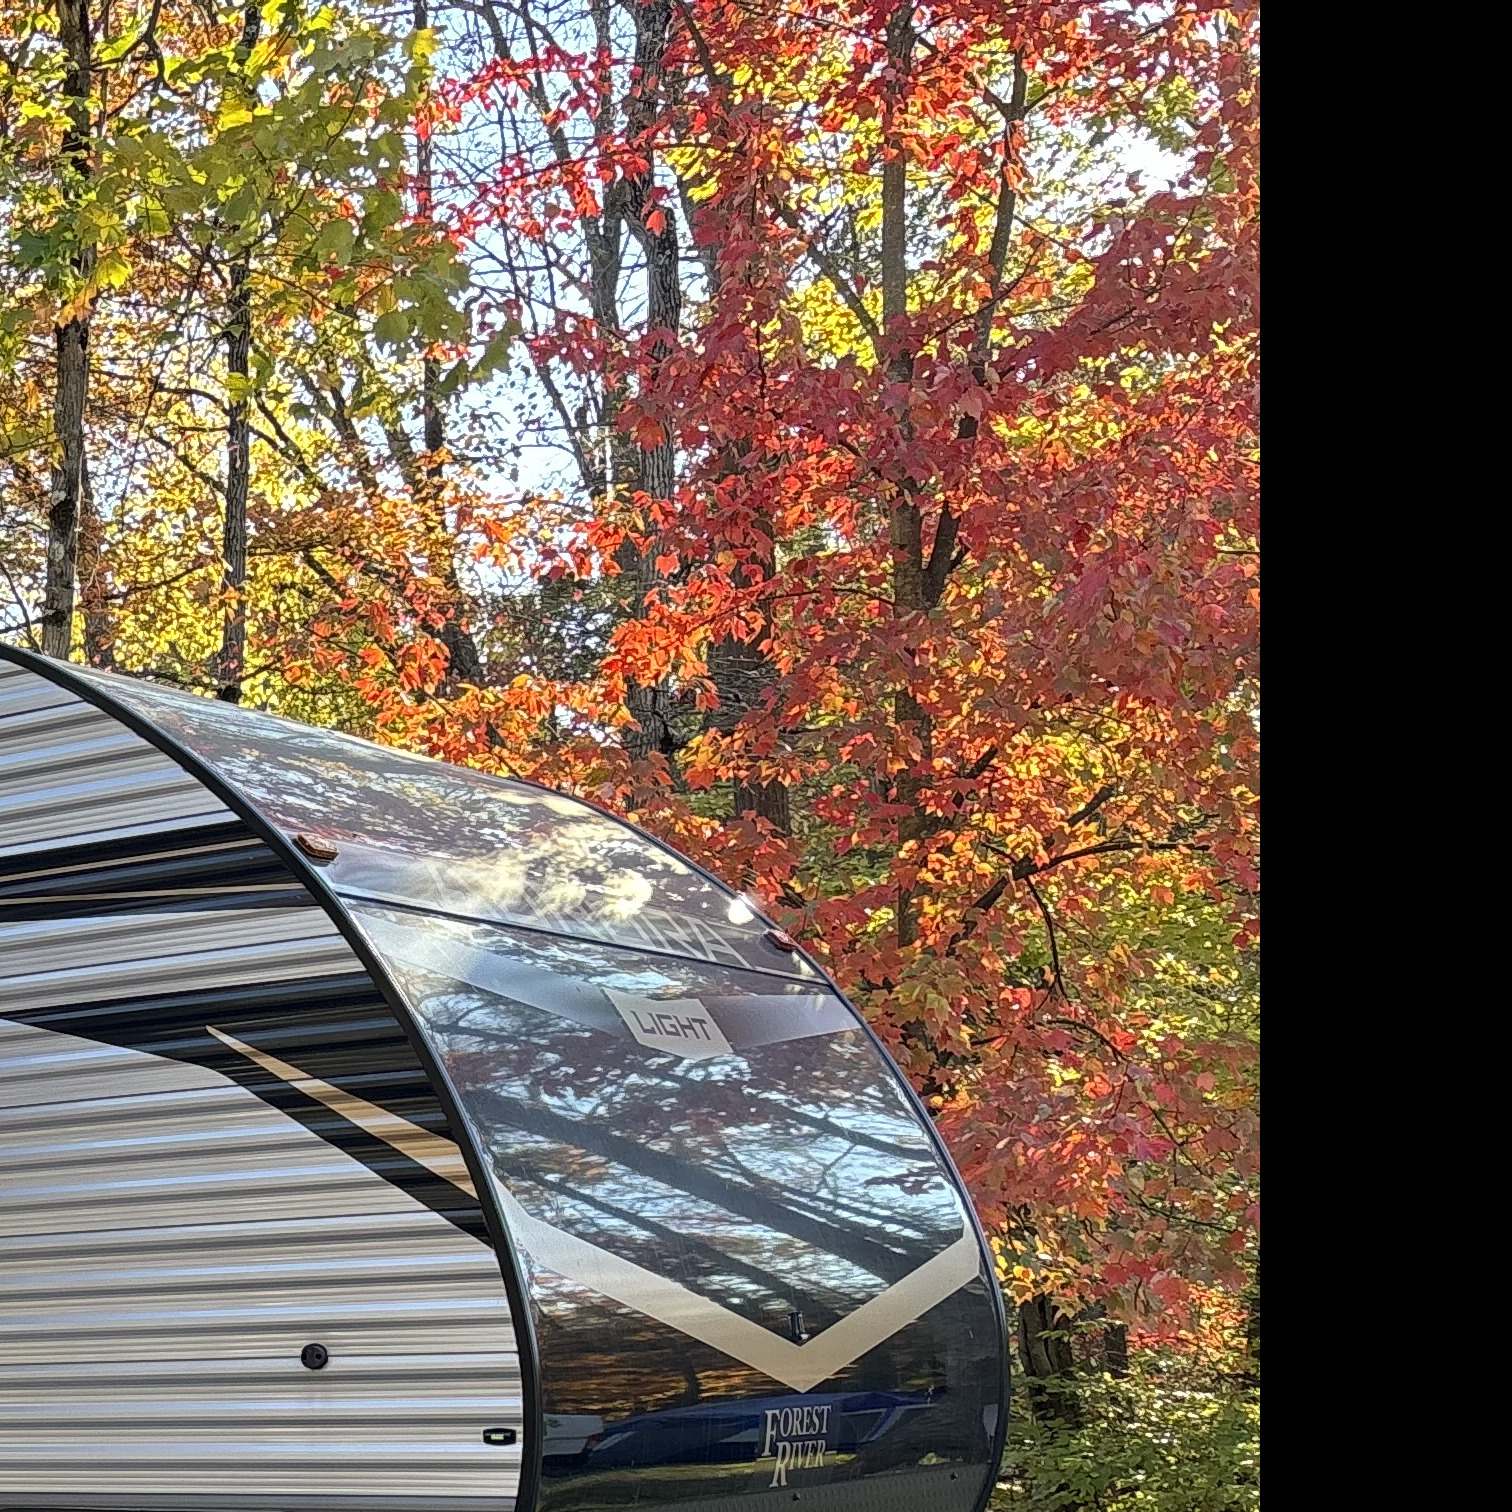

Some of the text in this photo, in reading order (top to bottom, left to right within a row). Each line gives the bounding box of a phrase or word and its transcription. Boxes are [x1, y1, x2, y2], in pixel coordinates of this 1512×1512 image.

[630, 1010, 712, 1041] LIGHT
[761, 1405, 832, 1457] FOREST
[769, 1440, 826, 1488] RIVER
